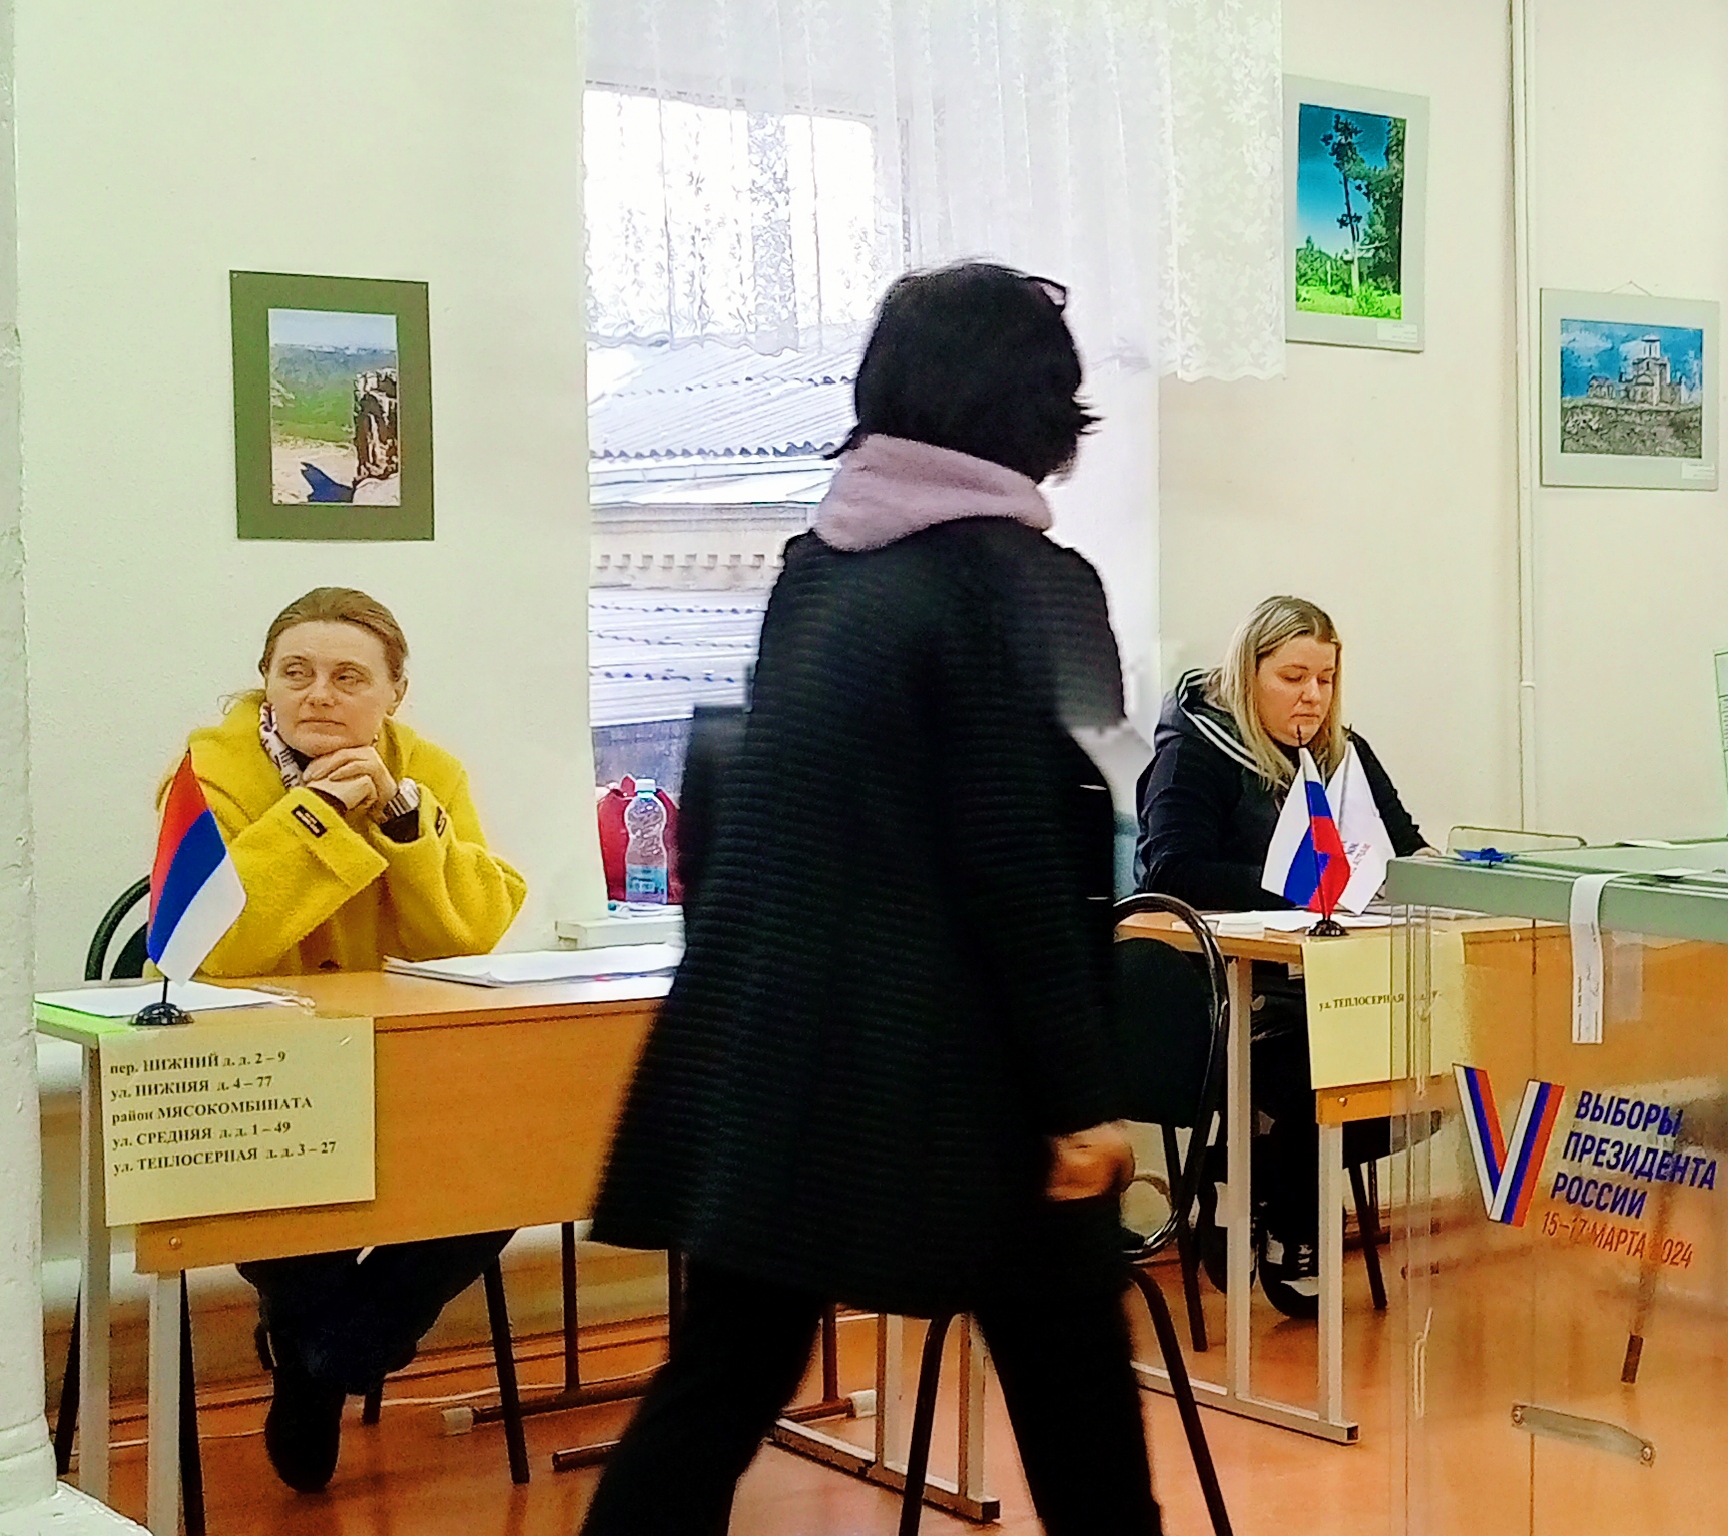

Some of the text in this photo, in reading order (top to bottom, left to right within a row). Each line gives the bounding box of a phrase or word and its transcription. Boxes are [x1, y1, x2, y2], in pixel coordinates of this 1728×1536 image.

[110, 1064, 138, 1076] пер.
[143, 1052, 219, 1072] НИЖНИЙ
[255, 1053, 262, 1064] 2
[277, 1051, 286, 1062] 9
[110, 1089, 131, 1102] ул.
[135, 1080, 209, 1097] НИЖНЯЯ
[233, 1077, 241, 1089] 4
[256, 1075, 272, 1088] 77
[112, 1097, 312, 1126] район МЯСОКОМБИНАТА
[1575, 1090, 1684, 1138] ВЫБОРЫ
[112, 1138, 133, 1151] ул.
[136, 1127, 212, 1145] СРЕДНЯЯ
[273, 1121, 291, 1134] 49
[113, 1163, 133, 1177] ул.
[137, 1147, 257, 1170] ТЕПЛОСЕРНАЯ
[297, 1143, 305, 1156] 3
[321, 1141, 336, 1154] 27
[1562, 1130, 1718, 1190] ПРЕЗИДЕНТА
[1550, 1171, 1648, 1219] РОССИИ
[1592, 1221, 1648, 1260] МАРТА
